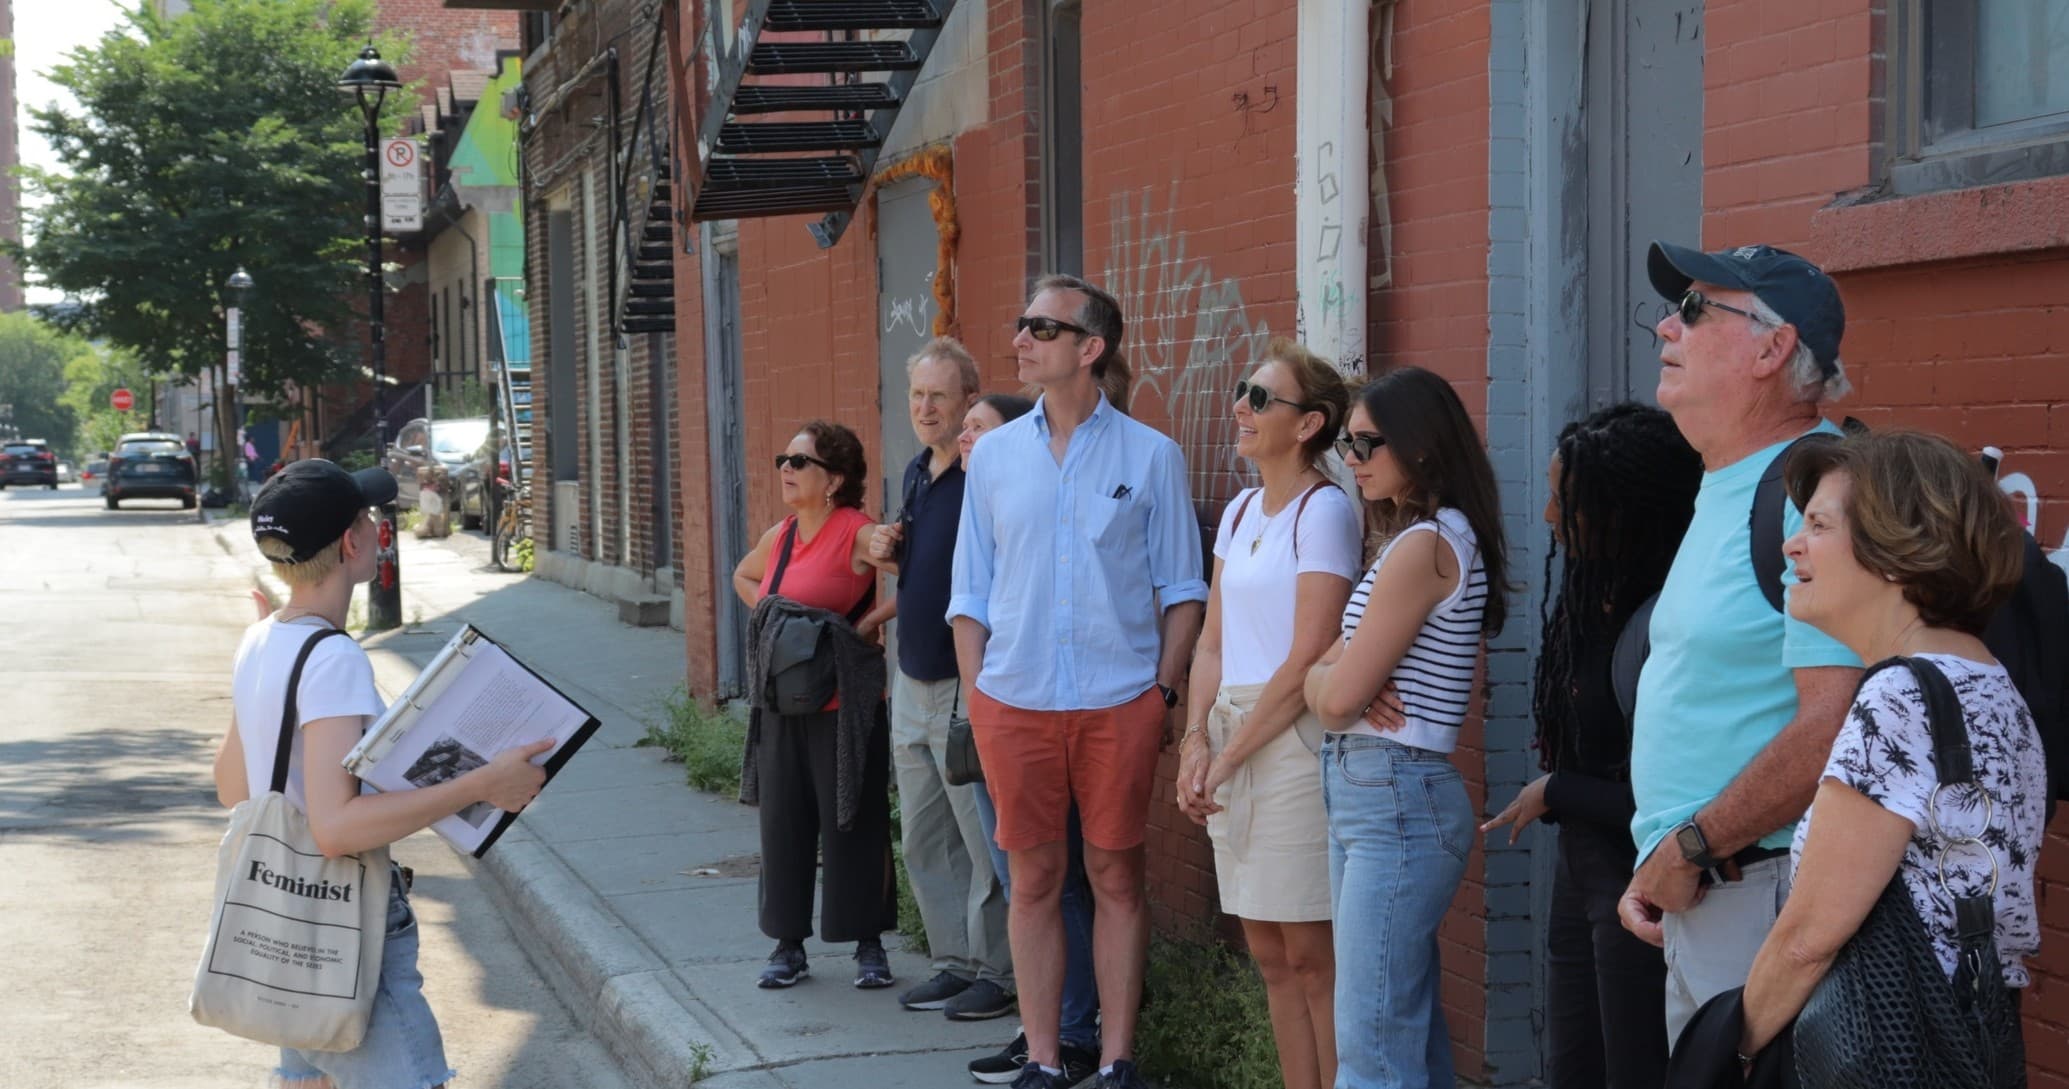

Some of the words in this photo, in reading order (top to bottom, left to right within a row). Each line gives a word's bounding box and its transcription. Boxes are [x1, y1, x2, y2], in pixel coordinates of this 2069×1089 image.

[247, 860, 352, 902] Feminist
[247, 930, 271, 943] PERSON
[272, 939, 289, 949] WHO
[327, 948, 339, 956] THE
[250, 948, 279, 961] EQUALITY
[280, 957, 290, 965] OF
[292, 959, 303, 968] THE
[293, 951, 308, 960] AND
